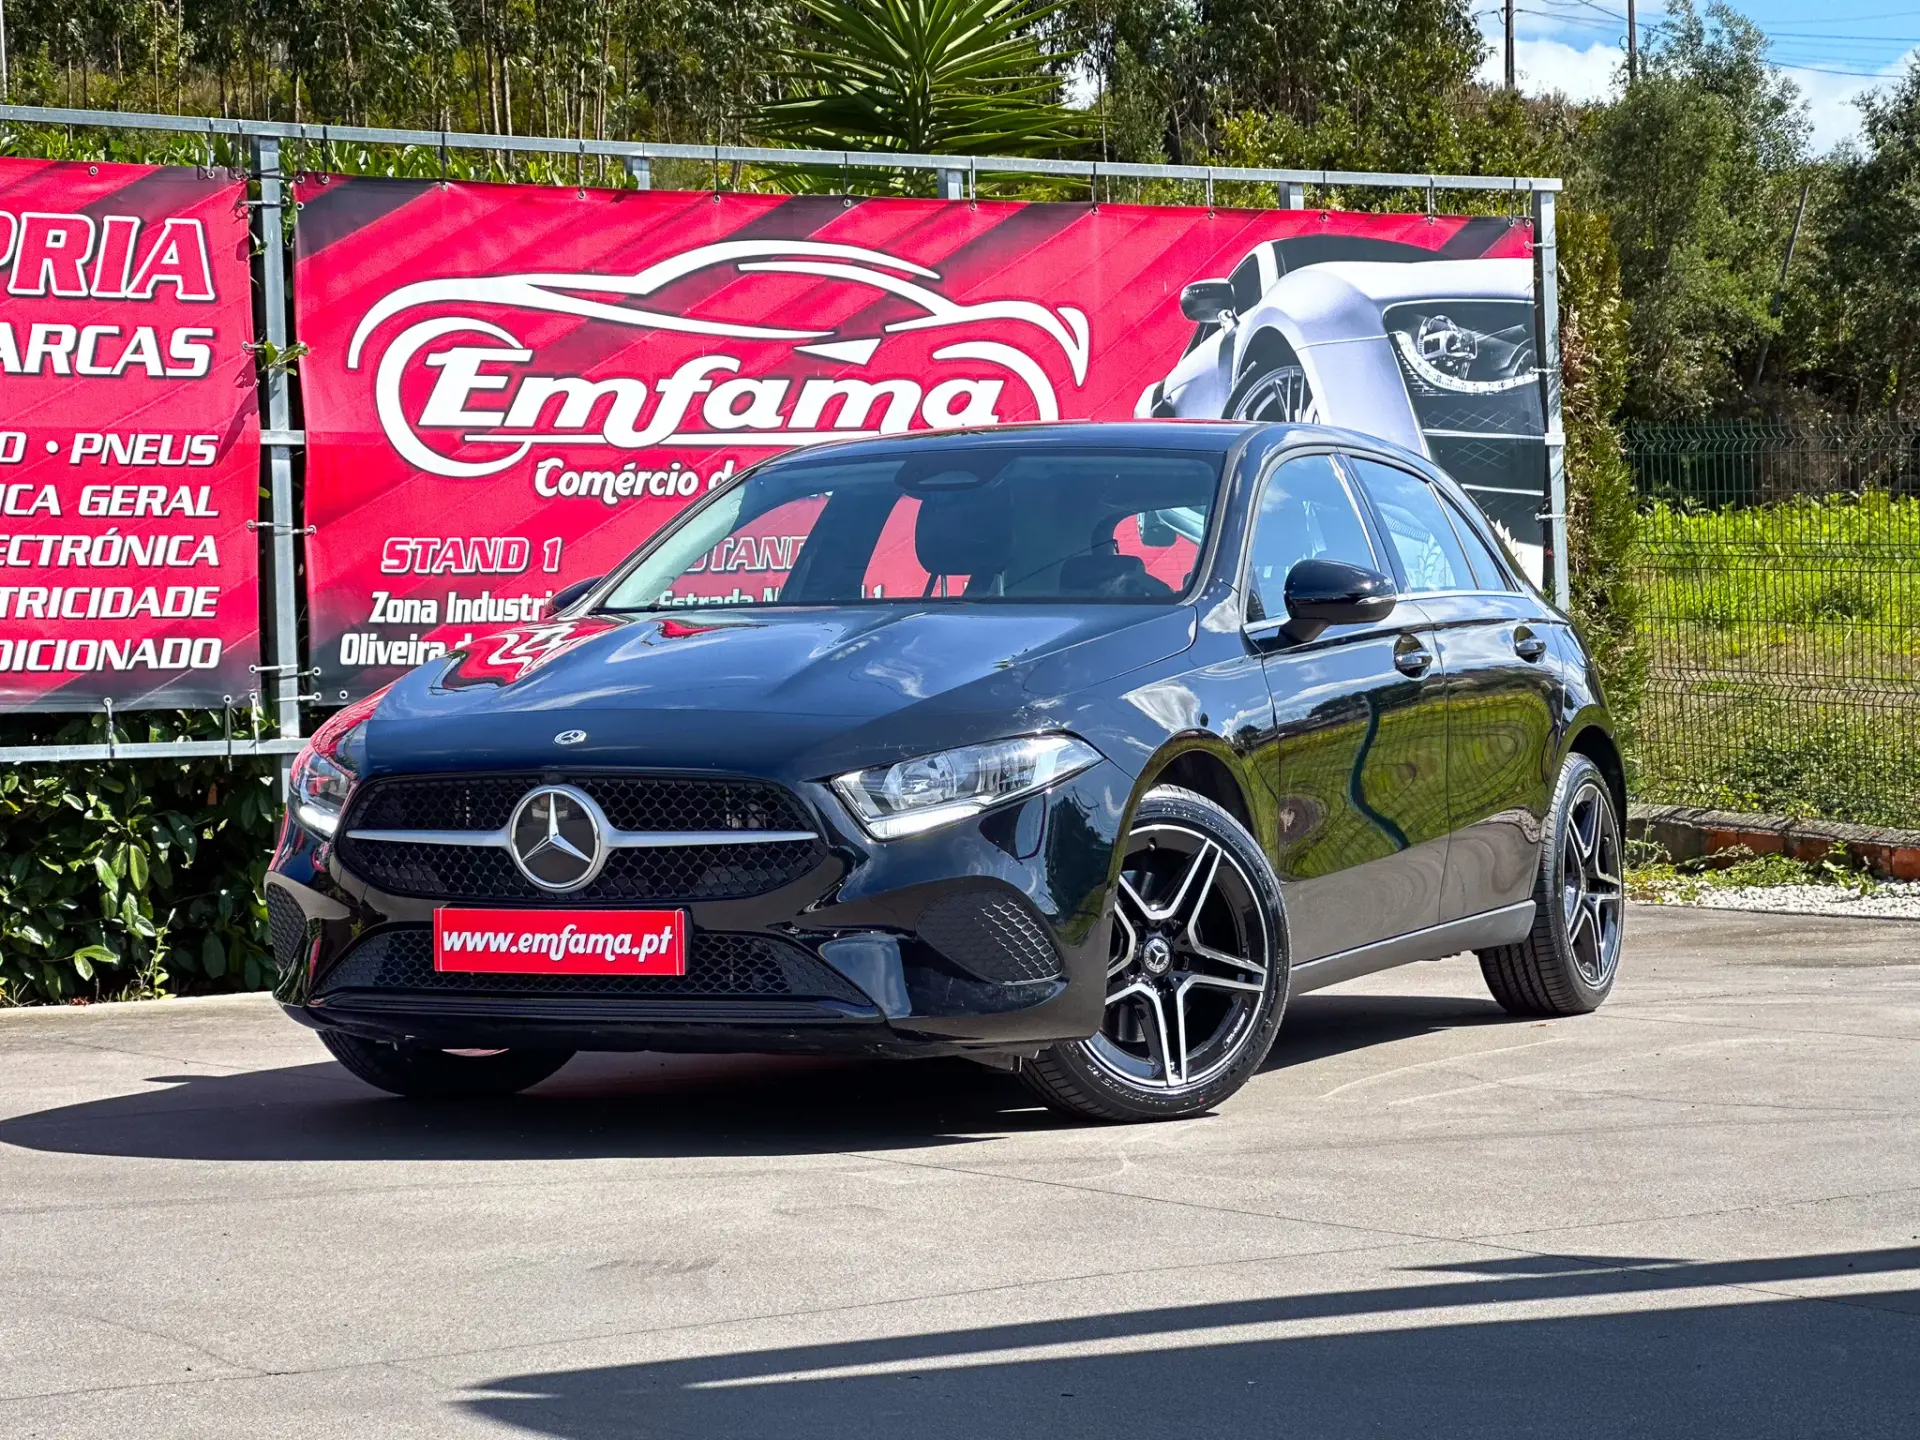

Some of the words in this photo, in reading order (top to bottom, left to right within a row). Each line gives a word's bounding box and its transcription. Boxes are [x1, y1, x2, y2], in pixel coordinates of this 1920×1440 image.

[0, 210, 216, 301] RIA
[418, 347, 1004, 448] Emfama
[68, 432, 219, 466] PNEUS
[534, 457, 698, 505] Comércio
[78, 485, 219, 517] GERAL
[381, 537, 529, 573] STAND
[543, 537, 562, 572] 1
[368, 591, 438, 624] Zona
[340, 633, 446, 666] Oliveira
[442, 924, 673, 962] www.emfama.pt
